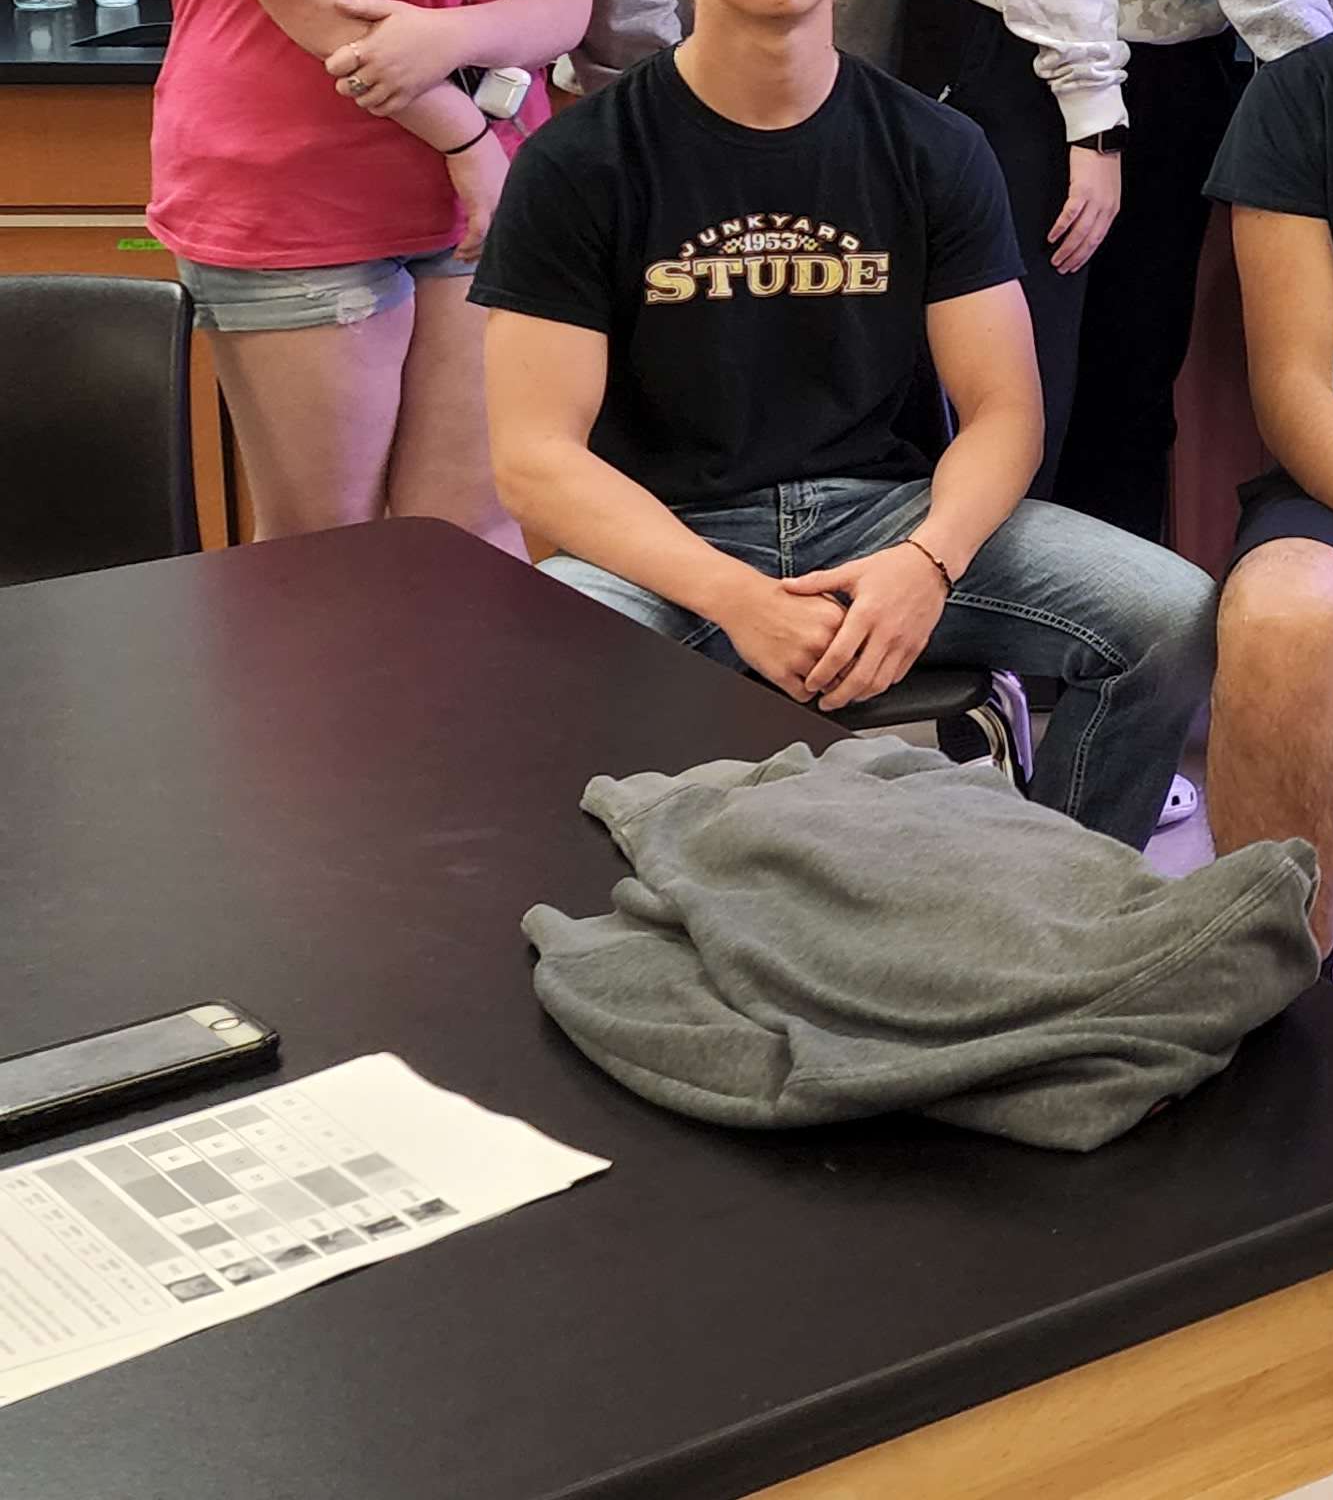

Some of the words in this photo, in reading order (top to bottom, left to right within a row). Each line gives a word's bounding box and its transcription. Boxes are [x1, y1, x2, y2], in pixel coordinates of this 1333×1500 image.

[678, 212, 862, 258] JUNKYARD
[742, 232, 798, 253] 1953
[645, 252, 890, 305] STUDE
